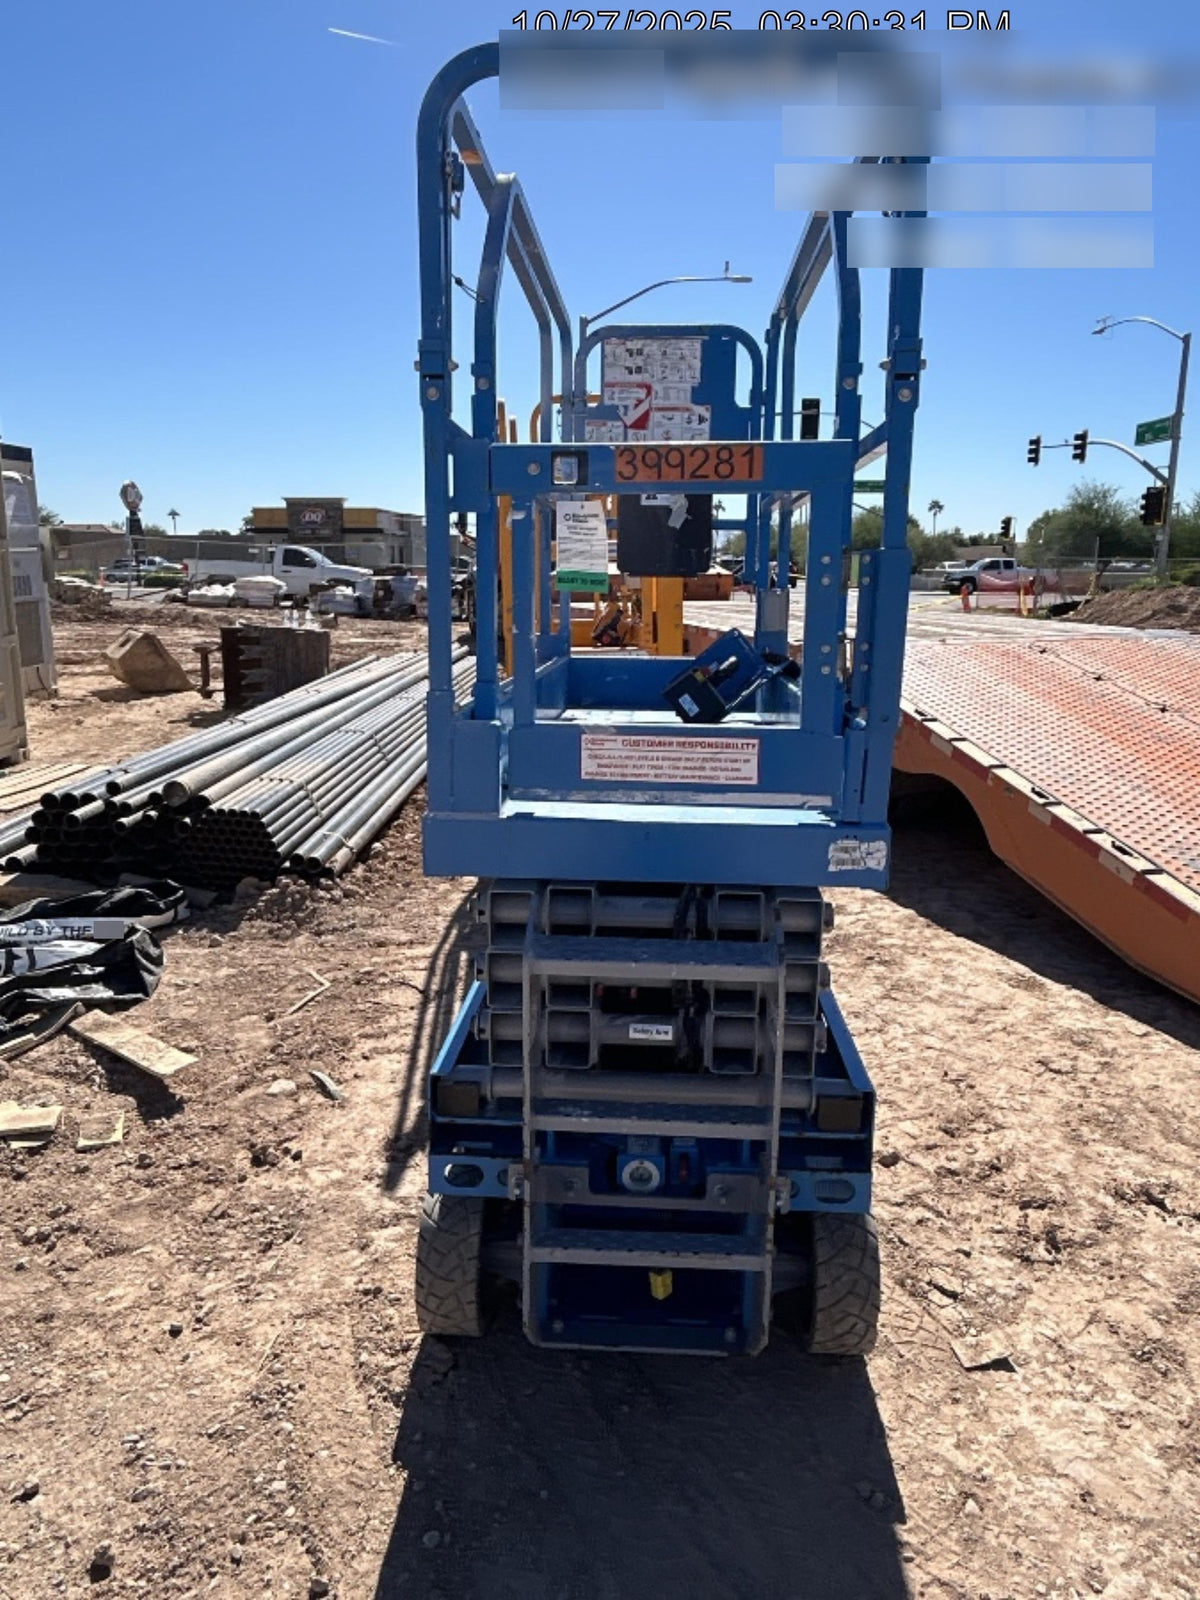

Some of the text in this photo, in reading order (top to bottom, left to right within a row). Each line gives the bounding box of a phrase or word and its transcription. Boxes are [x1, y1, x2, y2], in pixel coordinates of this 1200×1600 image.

[618, 445, 756, 480] 399281
[621, 739, 675, 748] CUSTOMER
[676, 741, 756, 751] RESPONSIBILITY
